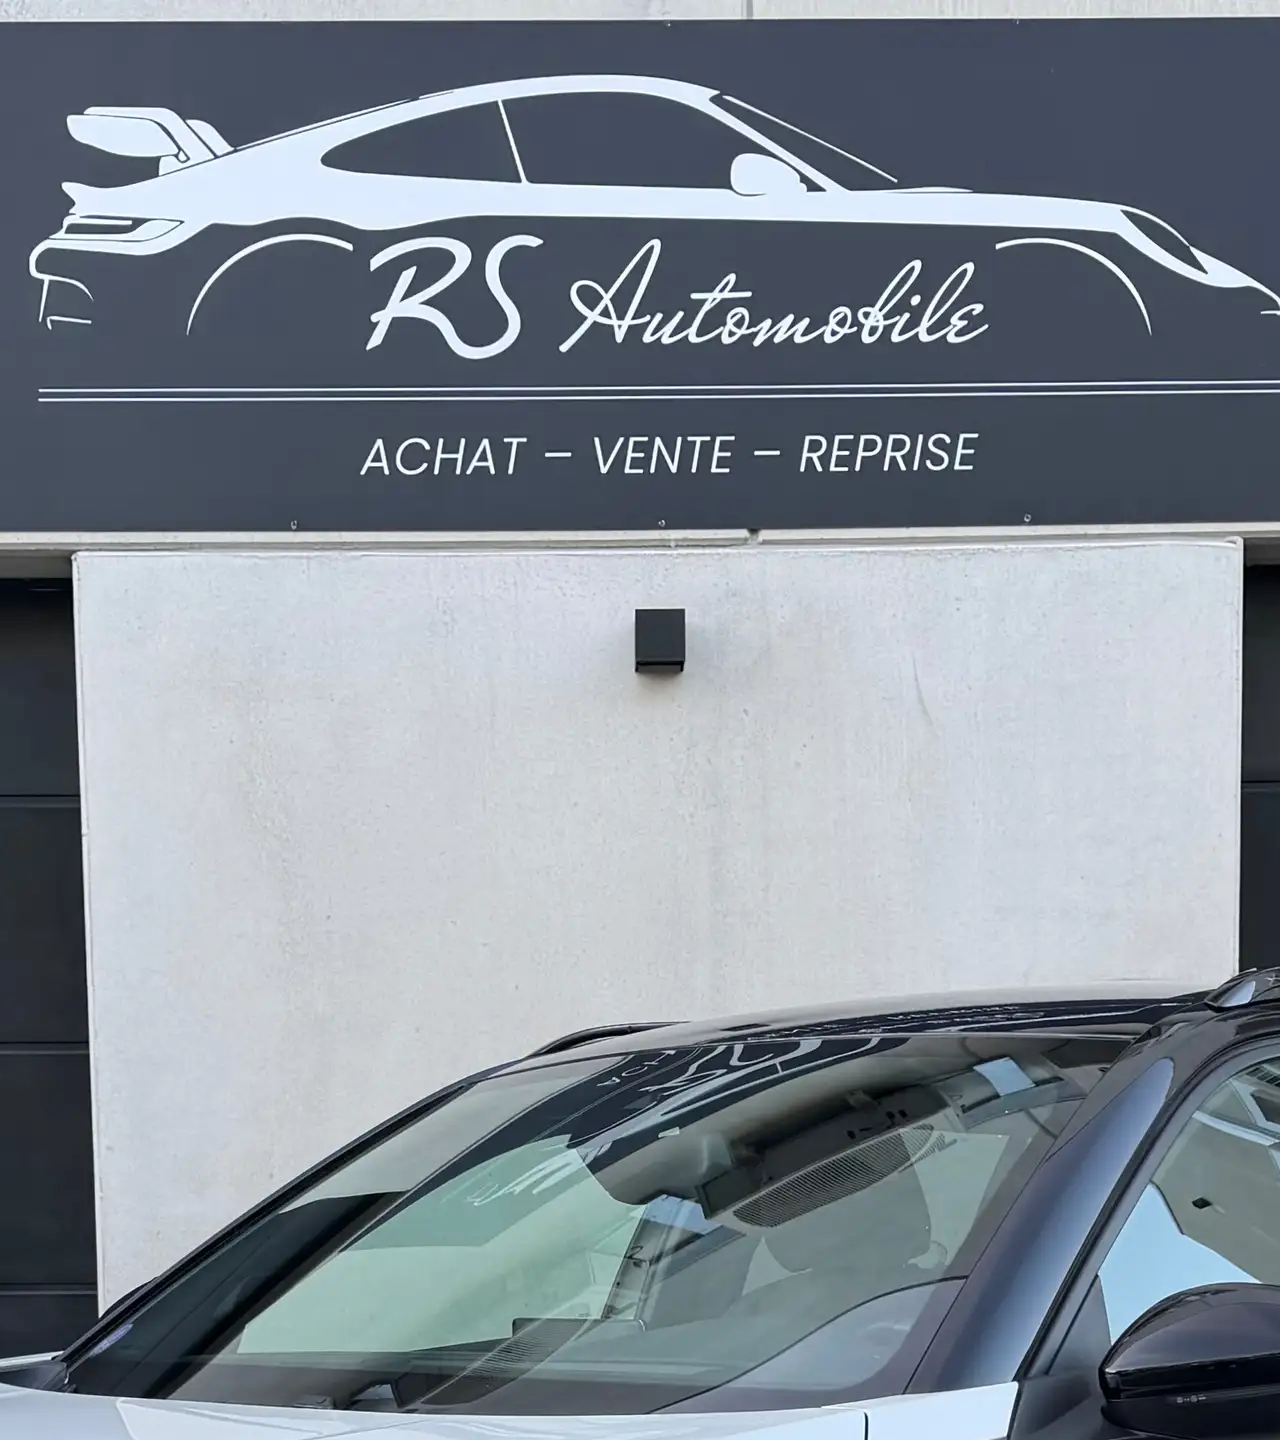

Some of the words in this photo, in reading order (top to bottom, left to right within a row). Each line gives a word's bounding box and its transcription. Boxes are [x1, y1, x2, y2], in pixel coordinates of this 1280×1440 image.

[366, 235, 543, 360] RS
[559, 239, 989, 353] Automobile
[360, 437, 528, 476] ACHAT
[593, 435, 736, 474] VENTE
[799, 433, 979, 473] REPRISE
